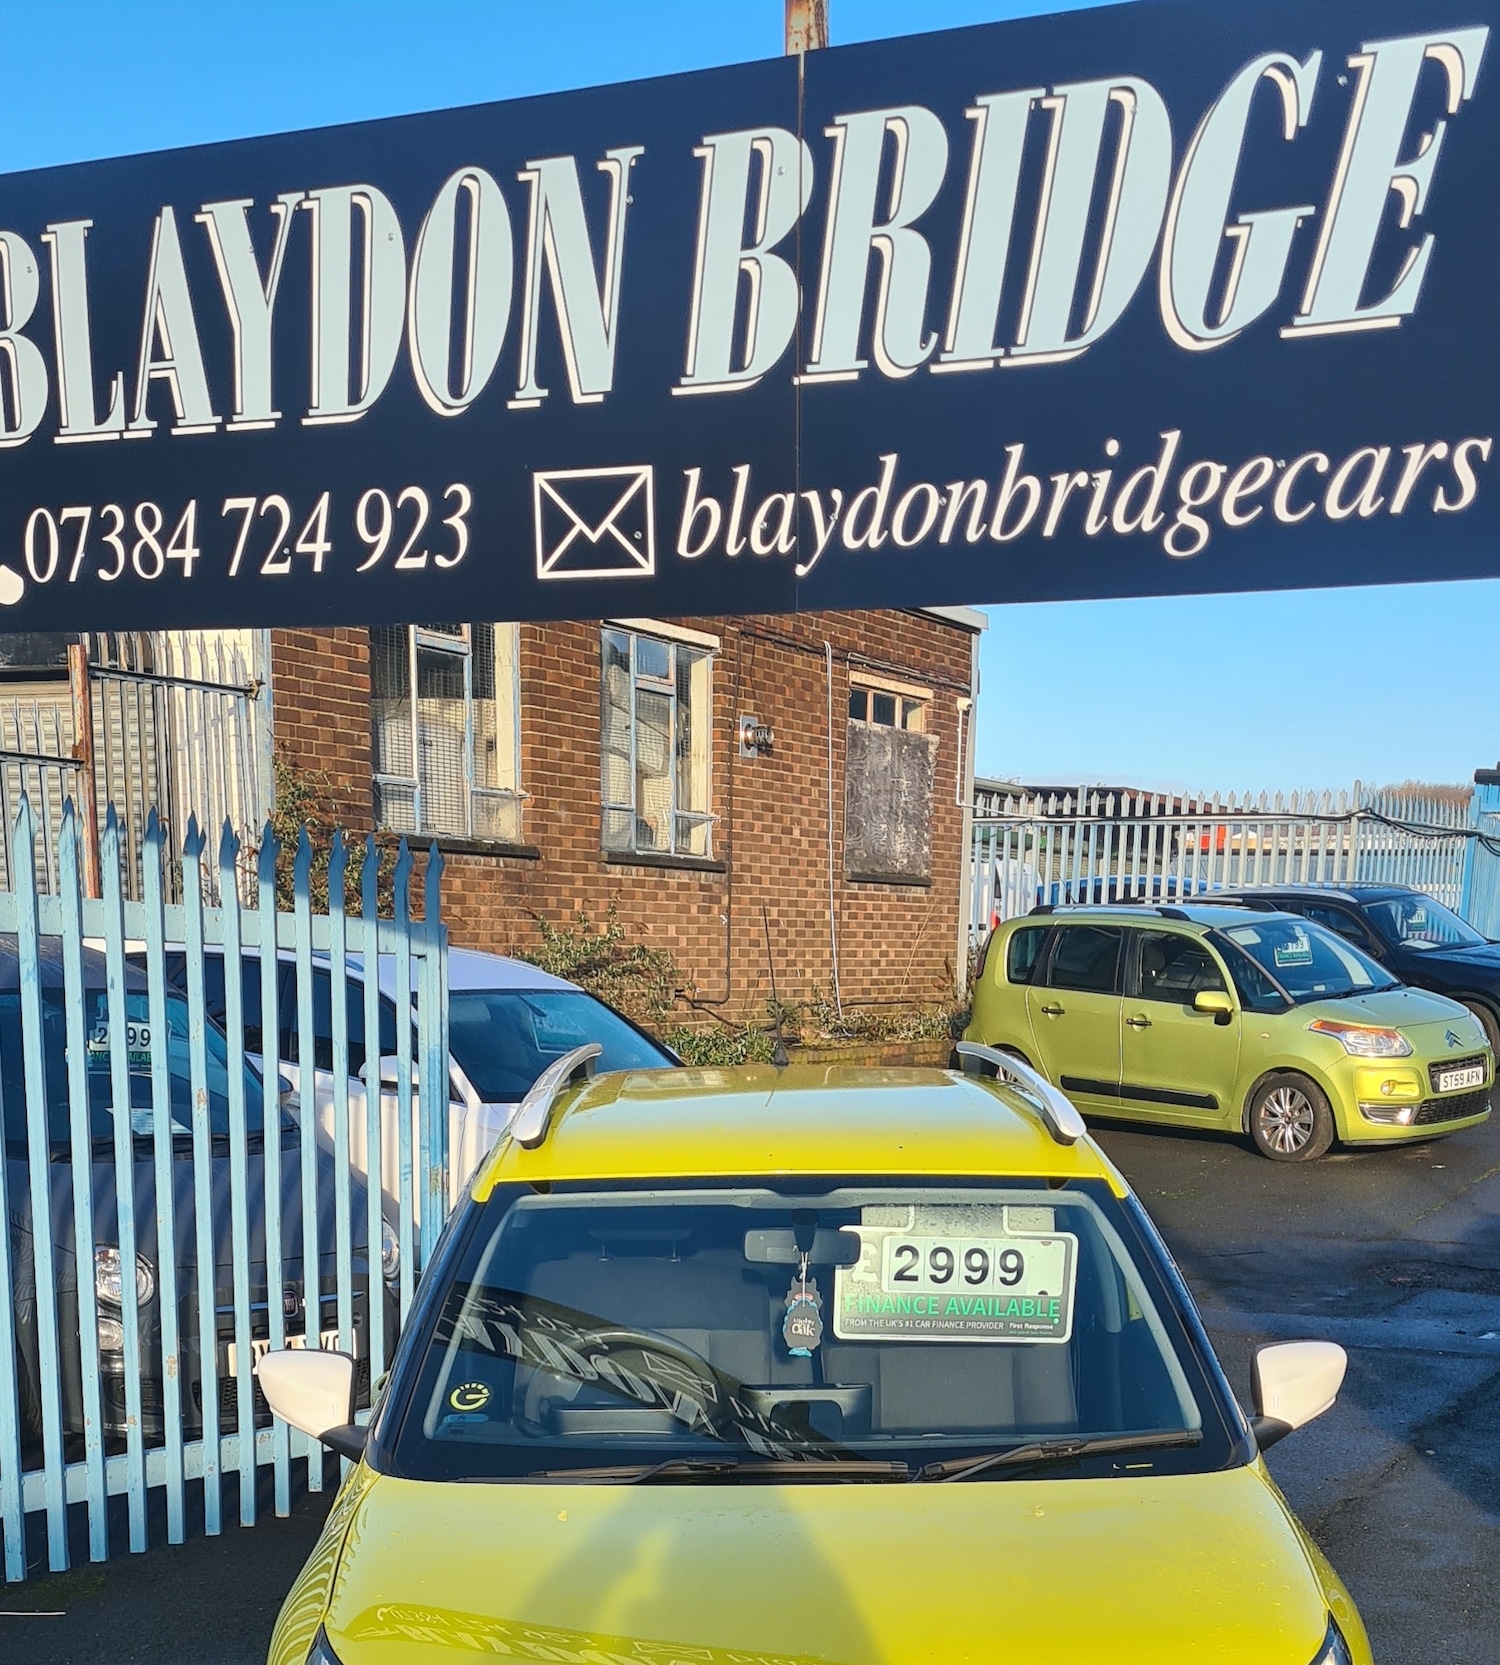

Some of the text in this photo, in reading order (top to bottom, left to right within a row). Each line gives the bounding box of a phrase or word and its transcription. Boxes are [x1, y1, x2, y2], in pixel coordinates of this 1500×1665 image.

[671, 26, 1490, 396] BRIDGE
[24, 429, 1493, 584] 07384 724 923 blaydonbridgecars
[98, 1026, 151, 1048] 299
[1443, 1069, 1481, 1089] ST59 AFN
[893, 1244, 1025, 1286] 2999
[844, 1293, 1061, 1318] FINANCE AVAILABLE
[844, 1318, 867, 1327] FROM
[869, 1319, 885, 1328] THE
[885, 1319, 904, 1328] UK'S
[915, 1320, 931, 1329] CAR
[931, 1320, 965, 1330] FINANCE
[966, 1321, 1005, 1330] PROVIDER
[1024, 1323, 1054, 1331] Response
